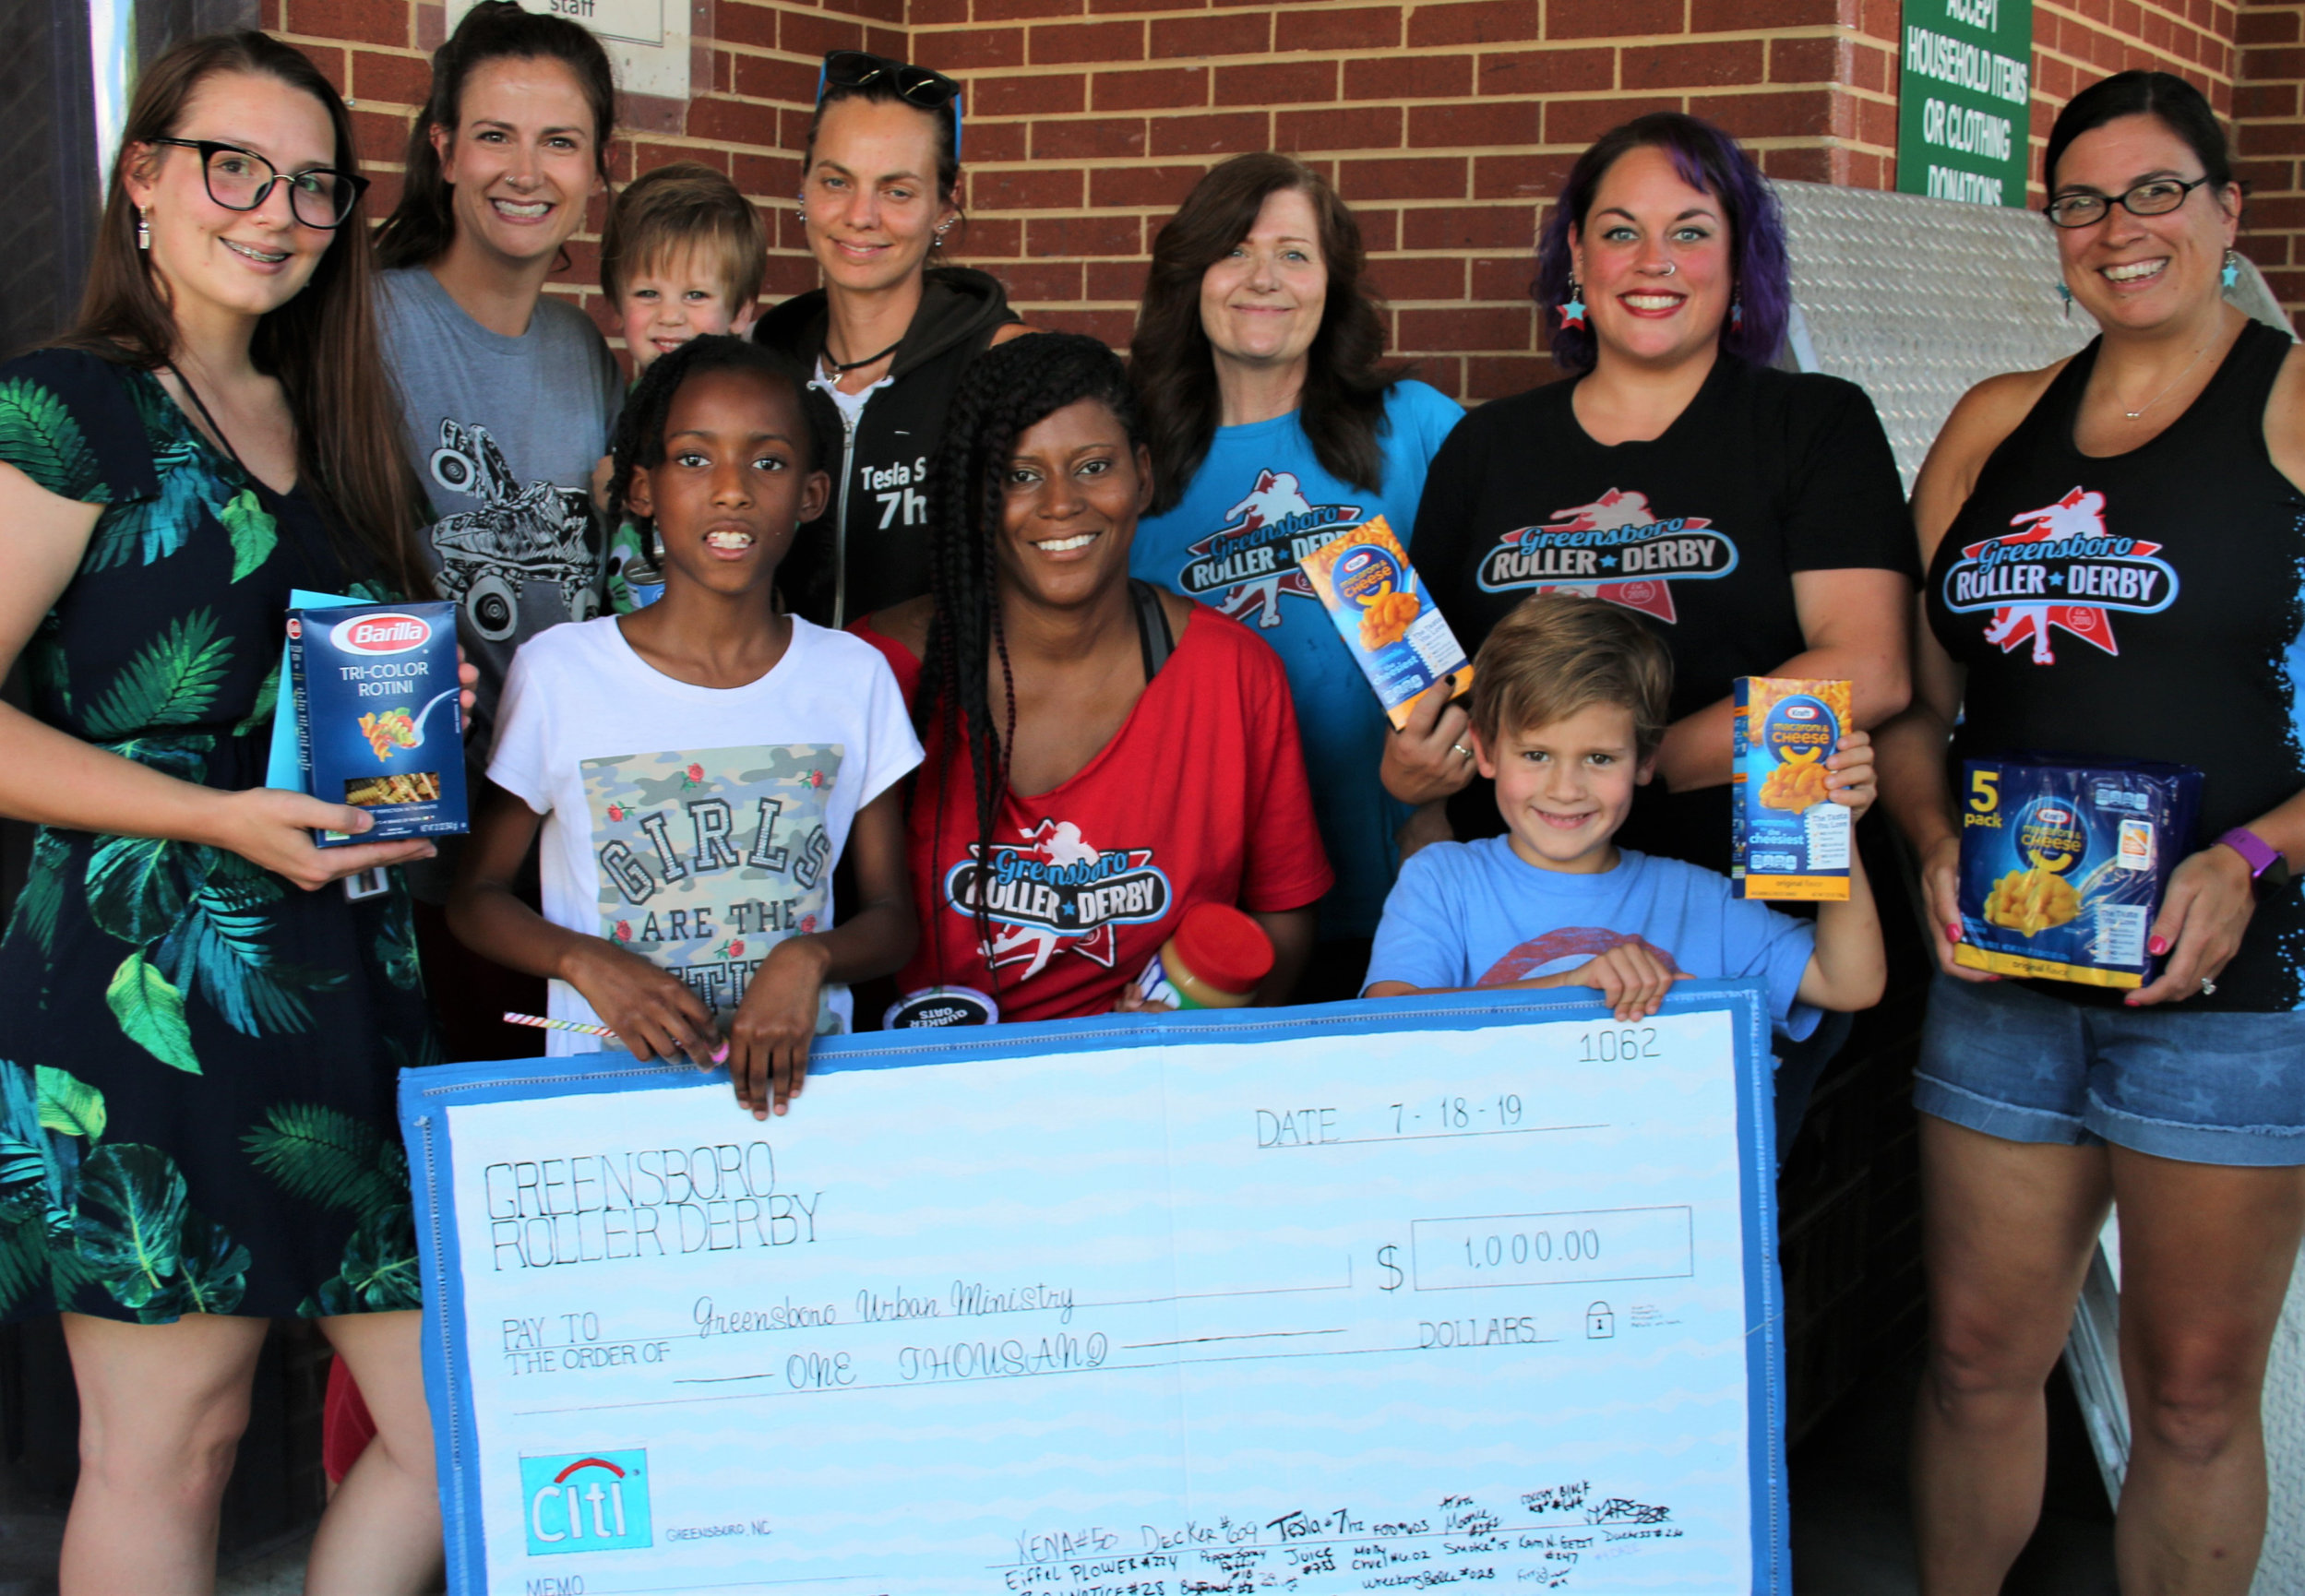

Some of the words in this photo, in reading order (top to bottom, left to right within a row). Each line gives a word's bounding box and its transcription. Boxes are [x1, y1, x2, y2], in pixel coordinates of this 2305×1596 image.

[1906, 25, 1990, 93] HOUSEHOLD
[1991, 54, 2027, 106] ITEMS
[1923, 98, 1945, 145] OR
[1946, 104, 2011, 161] CLOTHING
[1927, 164, 2002, 207] DONATIONS
[861, 462, 910, 491] Tesla
[1210, 507, 1338, 564] Greensboro
[1520, 518, 1685, 554] Greensboro
[1978, 532, 2134, 574] Greensboro
[1192, 546, 1276, 589] ROLLER
[1492, 549, 1597, 581] ROLLER
[1622, 539, 1716, 572] DERBY
[1956, 565, 2047, 601] ROLLER
[2067, 565, 2158, 601] DERBY
[354, 622, 424, 644] Barilla
[339, 661, 429, 681] TRI-COLOR
[358, 680, 413, 697] ROTINI
[1969, 770, 1999, 812] 5
[1964, 813, 2003, 828] pack
[600, 797, 830, 906] GIRLS
[641, 907, 712, 942] ARE
[729, 899, 797, 935] THE
[1078, 877, 1154, 923] DERBY
[919, 1007, 952, 1019] OATS
[1579, 1027, 1661, 1063] 1062
[1256, 1108, 1339, 1148] DATE
[484, 1140, 775, 1220] GREENSBORO
[491, 1205, 665, 1271] ROLLER
[677, 1190, 824, 1254] DERBY
[1377, 1243, 1404, 1294] $
[856, 1285, 941, 1322] Urban
[950, 1280, 1075, 1325] Ministry
[502, 1316, 546, 1351] PAY
[561, 1311, 600, 1343] TO
[1418, 1316, 1536, 1349] DOLLARS
[505, 1351, 556, 1376] THE
[563, 1343, 637, 1369] ORDER
[642, 1341, 671, 1364] OF
[787, 1351, 857, 1389] ONE
[899, 1331, 1108, 1380] THOUSAND
[526, 1575, 584, 1596] MEMO
